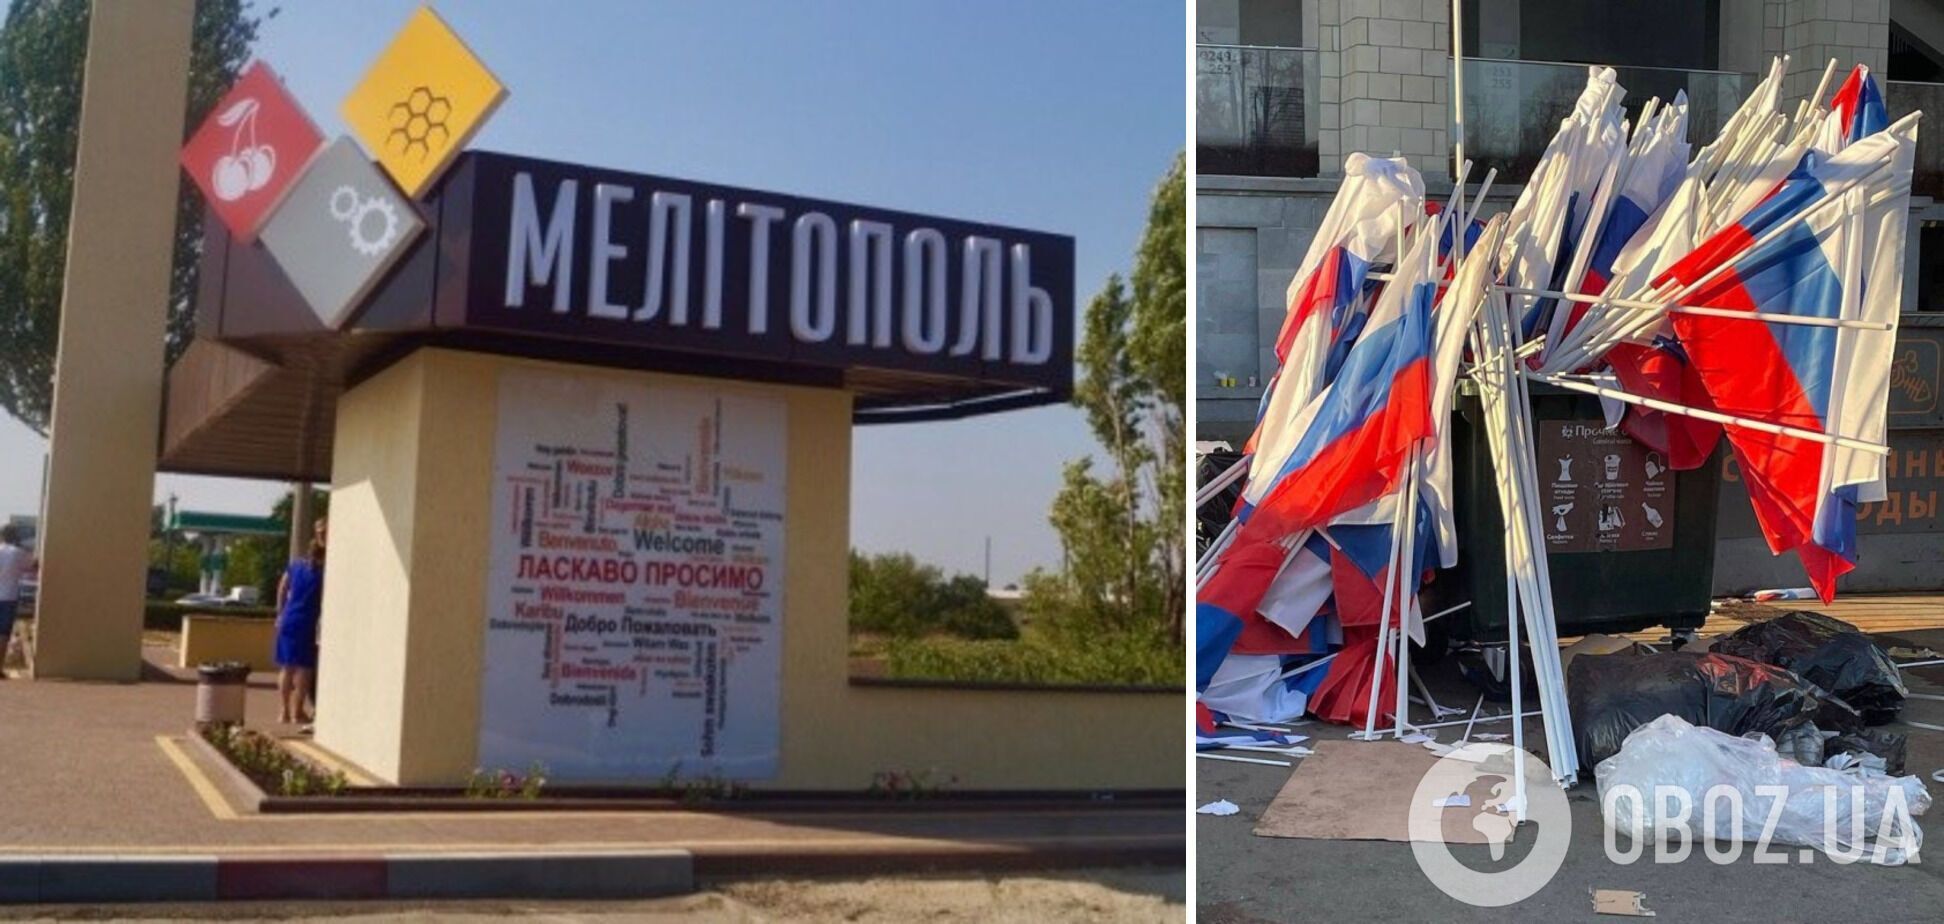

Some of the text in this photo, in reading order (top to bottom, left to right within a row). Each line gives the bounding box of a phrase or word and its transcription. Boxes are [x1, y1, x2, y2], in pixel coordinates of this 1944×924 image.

[504, 172, 1054, 366] МЕЛІТОПОЛЬ
[539, 530, 618, 552] Benvenuto
[634, 529, 725, 554] Welcome
[517, 554, 763, 590] ЛАСКАВО ПРОСИМО
[515, 602, 564, 620] Karibu
[565, 613, 617, 634] Добро
[621, 616, 717, 637] Пожаловать
